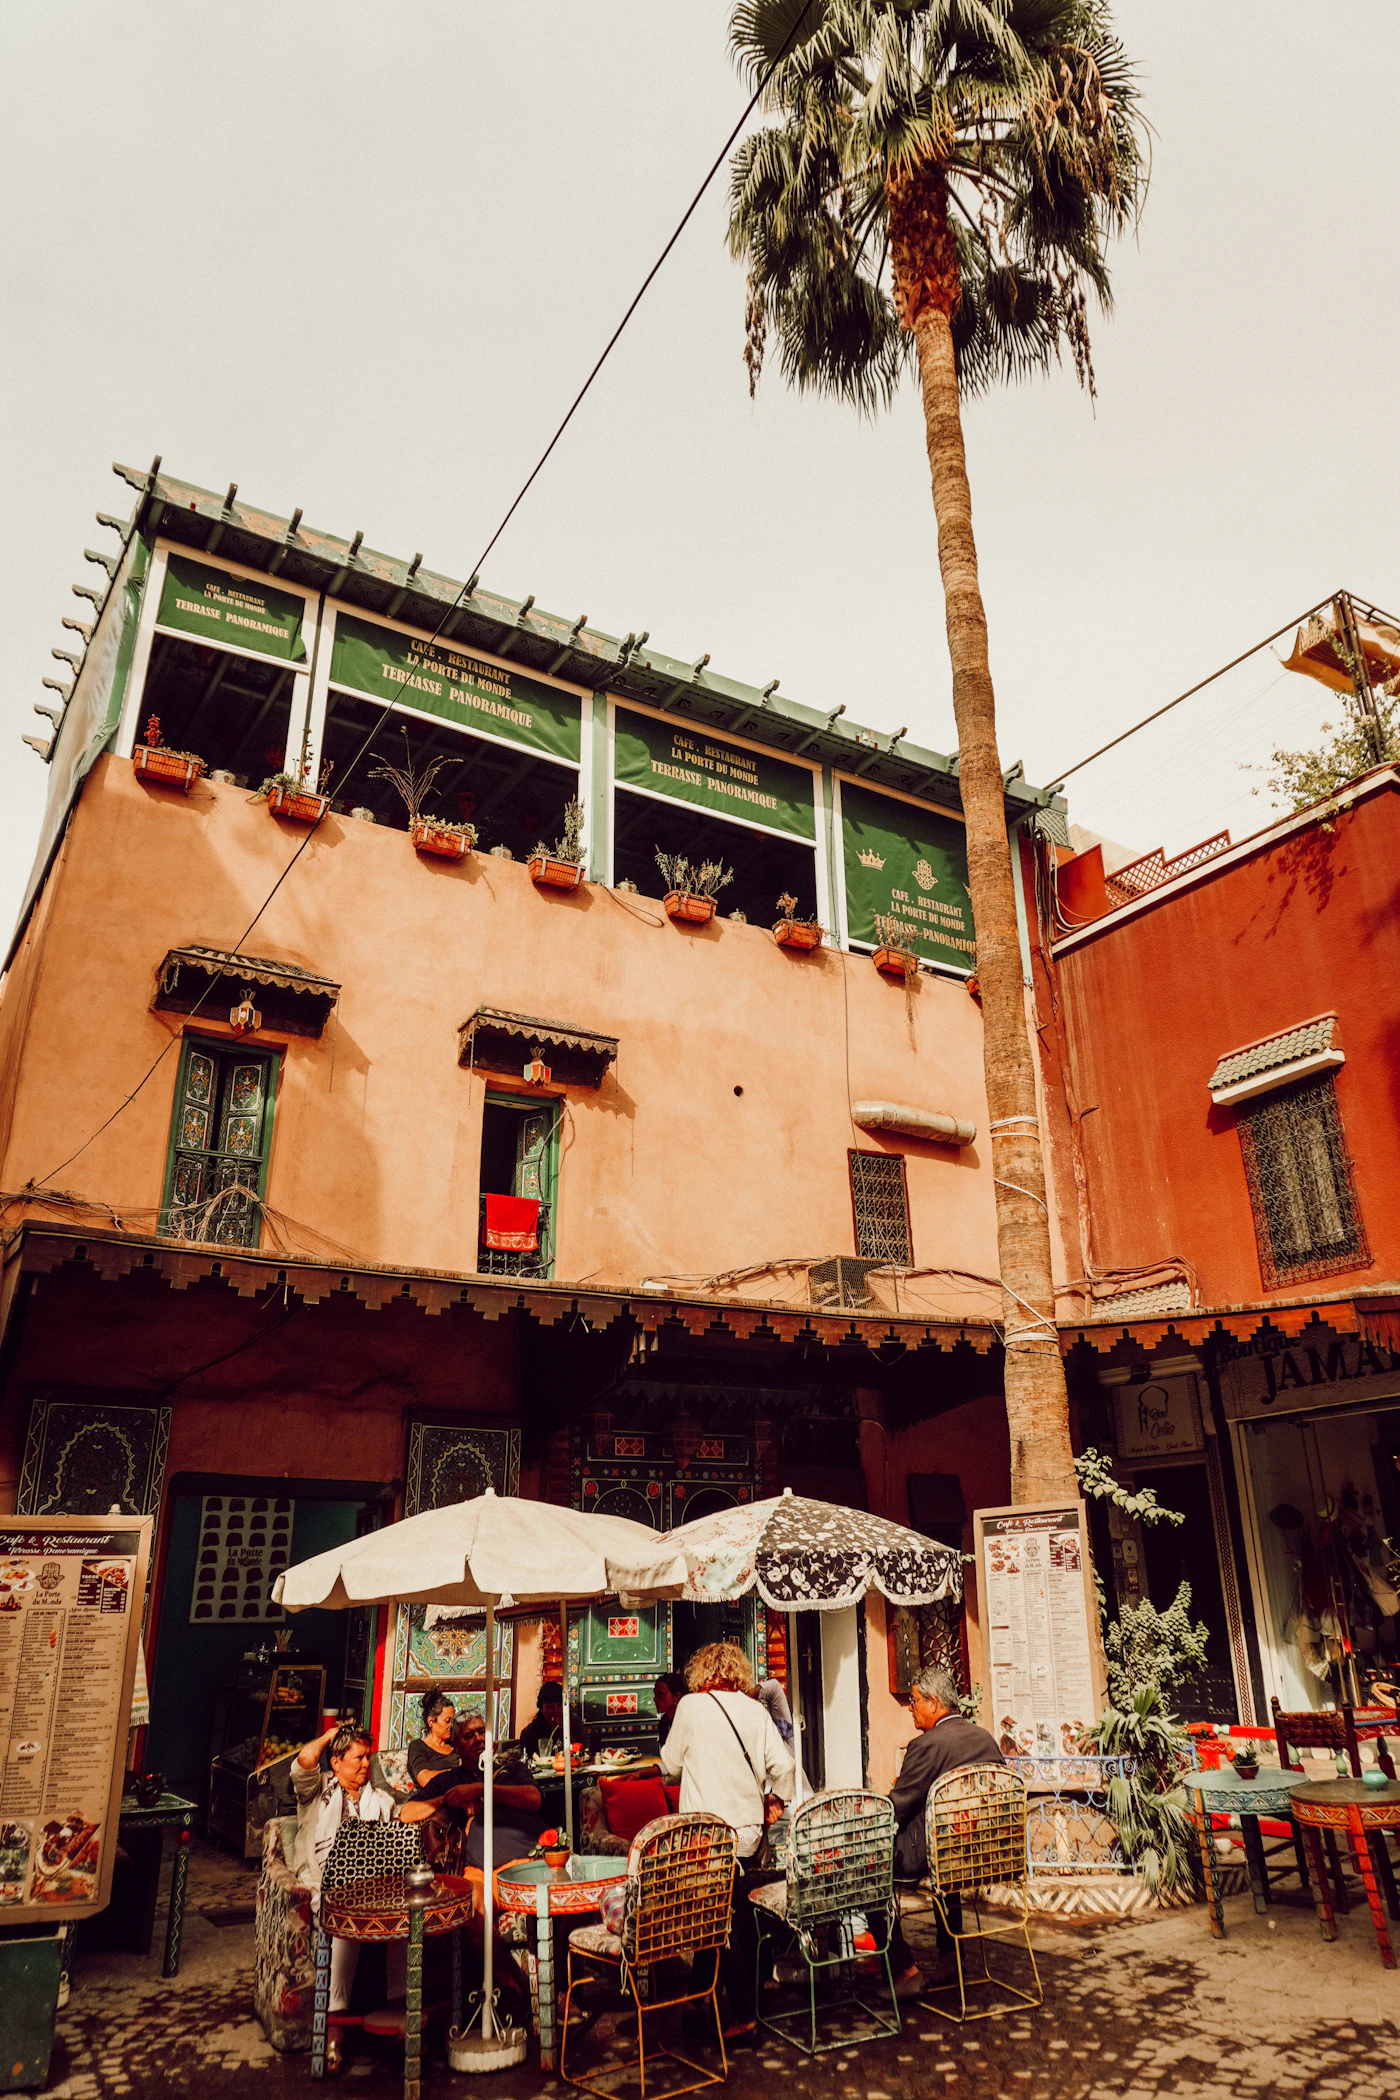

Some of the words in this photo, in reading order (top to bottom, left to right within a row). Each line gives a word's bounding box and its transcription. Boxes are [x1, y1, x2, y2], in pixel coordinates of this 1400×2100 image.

[203, 590, 212, 598] LA
[213, 592, 234, 606] PORTE
[235, 600, 244, 608] DU
[245, 602, 266, 614] MONDE
[206, 583, 221, 593] CAFE
[227, 589, 265, 606] RESTAURANT
[175, 598, 221, 620] TERRASSE
[225, 612, 289, 639] PANORAMIQUE
[407, 652, 420, 667] LA
[422, 658, 458, 681] PORTE
[460, 671, 476, 686] DU
[477, 676, 512, 700] MONDE
[411, 639, 436, 657] CAFE
[448, 652, 511, 685] RESTAURANT
[381, 663, 443, 696] TERRASSE
[449, 687, 533, 728] PANORAMIQUE
[671, 747, 683, 760] LA
[684, 751, 714, 771] PORTE
[715, 762, 728, 775] DU
[729, 766, 759, 786] MONDE
[673, 734, 694, 750] CAFE
[705, 745, 757, 772] RESTAURANT
[651, 759, 702, 786] TERRASSE
[707, 777, 777, 810] PANORAMIQUE
[891, 888, 909, 902] CAFE
[917, 896, 963, 918] RESTAURANT
[891, 901, 901, 913] LA
[902, 904, 928, 921] PORTE
[928, 912, 939, 924] DU
[939, 915, 966, 932] MONDE
[1219, 1334, 1300, 1362] Boutique
[1151, 1421, 1175, 1440] Celia
[1023, 1516, 1065, 1528] Restaurant
[8, 1546, 42, 1556] Terrasse
[43, 1547, 99, 1556] Panoramique
[42, 1535, 114, 1548] Restaurant
[228, 1548, 238, 1557] La
[240, 1548, 263, 1557] Porte
[227, 1557, 236, 1566] du
